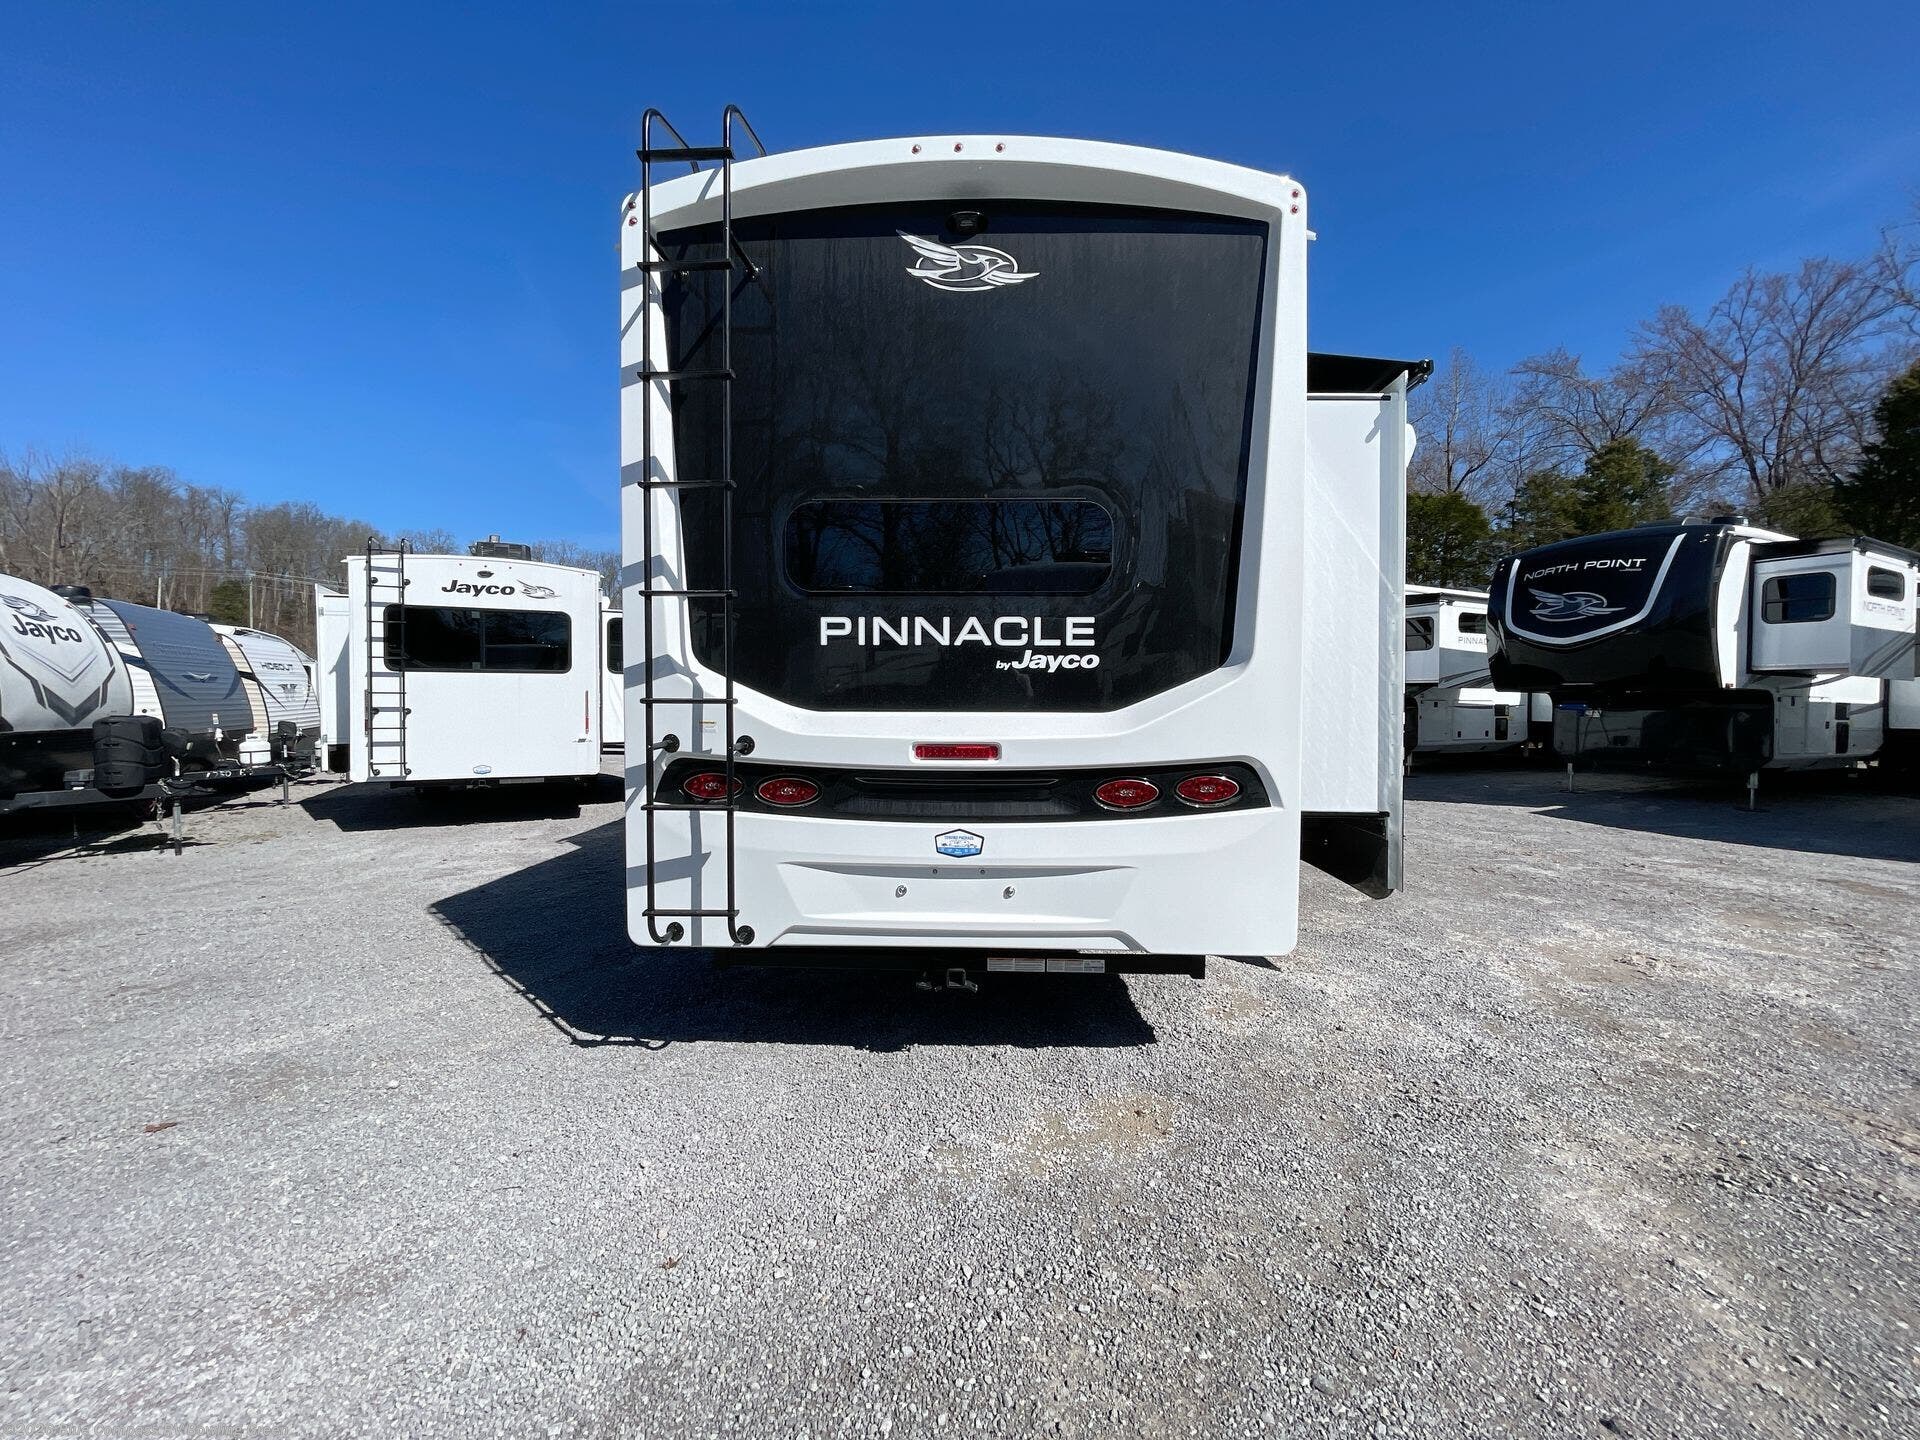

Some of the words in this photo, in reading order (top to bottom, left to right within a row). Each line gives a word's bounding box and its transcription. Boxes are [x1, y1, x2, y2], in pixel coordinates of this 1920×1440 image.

[1523, 563, 1579, 581] NORTH
[1583, 558, 1647, 570] POINT
[441, 579, 516, 598] Jayco
[12, 613, 83, 645] Jayco
[819, 616, 1096, 647] PINNACLE
[995, 660, 1012, 671] by
[1011, 649, 1100, 673] Jayco
